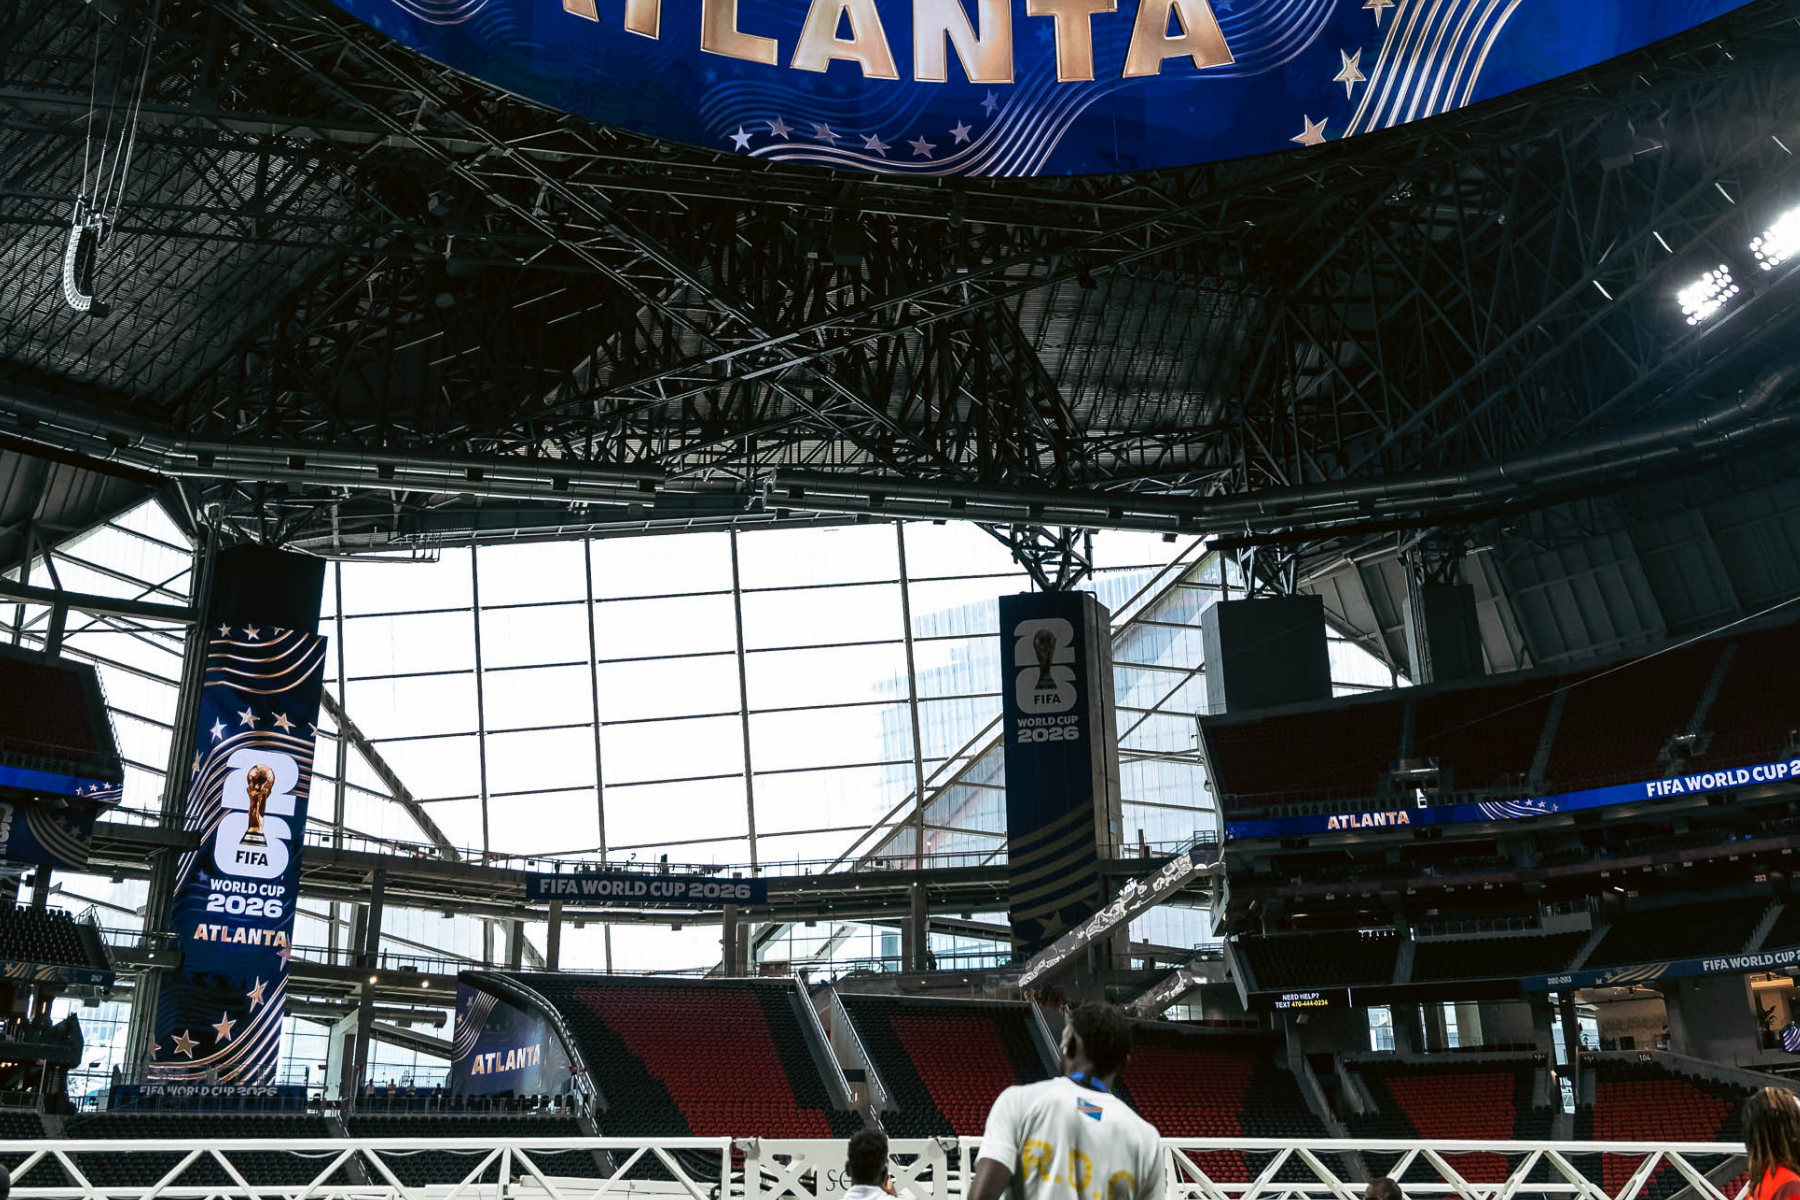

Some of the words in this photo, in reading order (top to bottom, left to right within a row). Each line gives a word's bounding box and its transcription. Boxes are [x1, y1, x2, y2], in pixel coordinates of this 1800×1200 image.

[562, 0, 1235, 83] LANTA
[1033, 694, 1061, 705] FIFA
[1017, 716, 1056, 727] WORLD
[1056, 715, 1079, 726] CUP
[1017, 726, 1079, 743] 2026
[1646, 779, 1685, 797] FIFA
[1685, 769, 1750, 791] WORLD
[1752, 763, 1788, 781] CUP
[1327, 810, 1410, 830] ATLANTA
[235, 850, 269, 866] FIFA
[210, 878, 258, 894] WORLD
[259, 884, 285, 897] CUP
[540, 878, 579, 894] FIFA
[581, 879, 647, 896] WORLD
[650, 881, 686, 897] CUP
[688, 882, 751, 899] 2026
[206, 893, 283, 918] 2026
[193, 923, 288, 947] ATLANTA
[1702, 958, 1729, 971] FIFA
[1729, 954, 1774, 968] WORLD
[1775, 951, 1795, 963] CUP
[471, 1044, 540, 1075] ATLANTA
[140, 1086, 165, 1096] FIFA
